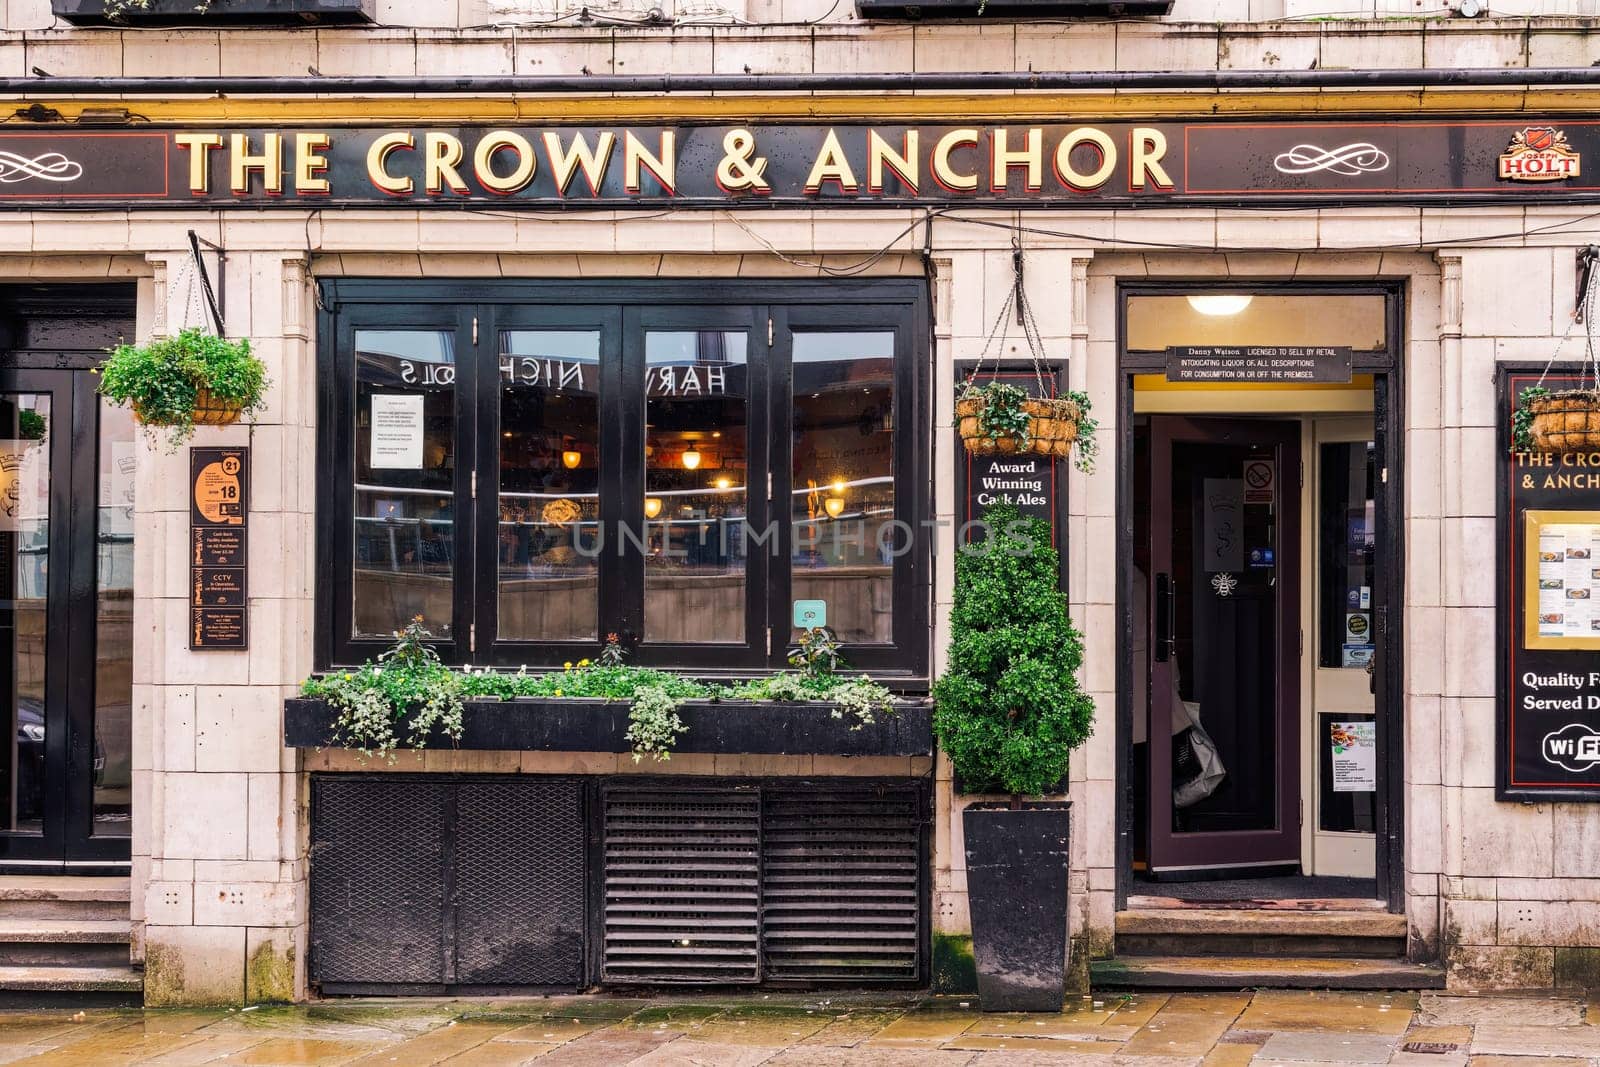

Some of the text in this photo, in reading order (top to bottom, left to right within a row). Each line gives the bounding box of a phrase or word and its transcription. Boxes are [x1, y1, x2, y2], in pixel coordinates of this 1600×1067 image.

[175, 126, 1175, 197] THE CROWN & ANCHOR
[1504, 159, 1576, 173] HOLT
[226, 462, 237, 470] 21
[989, 462, 1035, 473] Award
[1516, 453, 1600, 468] THE CRO
[982, 478, 1042, 491] Winning
[1522, 474, 1600, 488] & ANCH
[220, 486, 236, 498] 18
[1016, 494, 1046, 505] Ales
[1523, 672, 1600, 690] Quality F
[1524, 696, 1582, 710] Served
